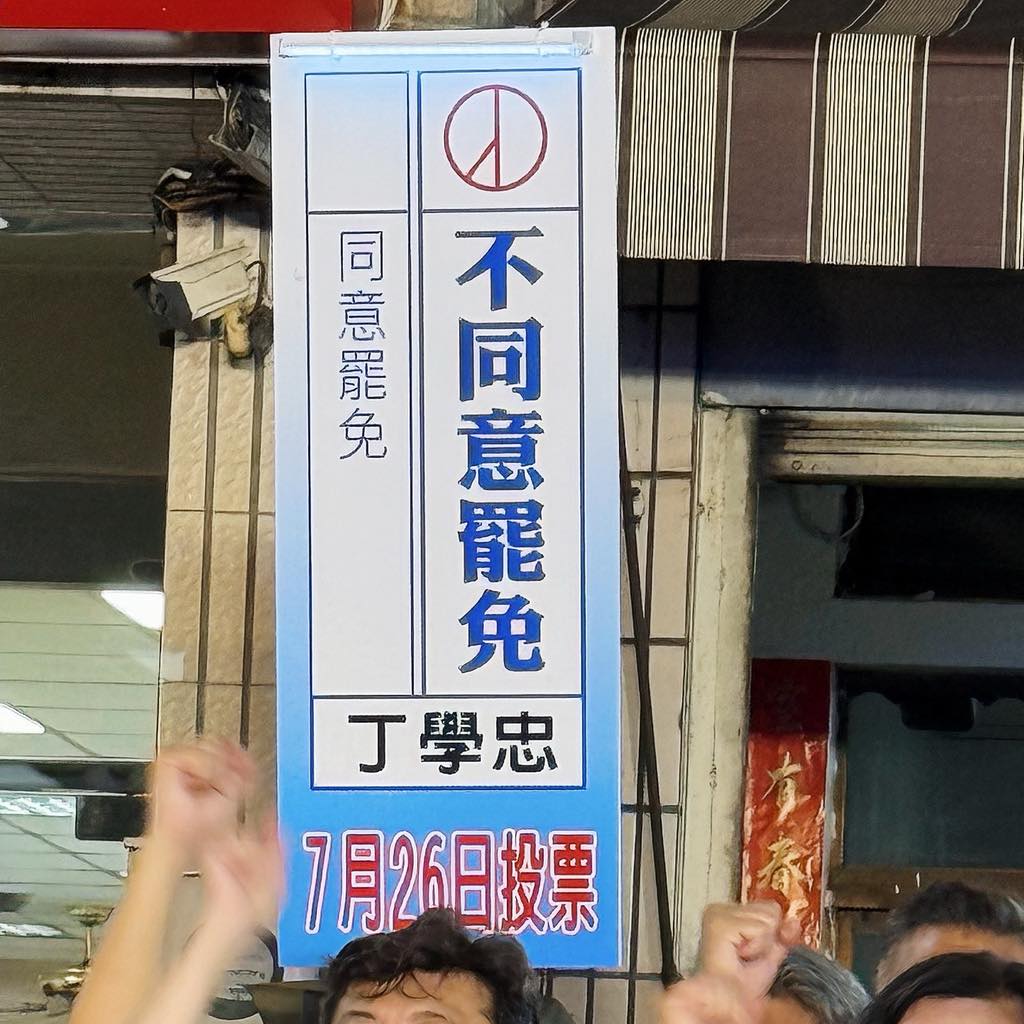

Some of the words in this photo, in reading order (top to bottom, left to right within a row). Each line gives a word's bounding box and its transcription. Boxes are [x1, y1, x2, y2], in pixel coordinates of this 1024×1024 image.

[338, 230, 388, 460] 同意罷免
[454, 225, 546, 674] 不同意罷免
[347, 710, 558, 776] 丁學忠
[302, 829, 600, 934] 7月26日投票
